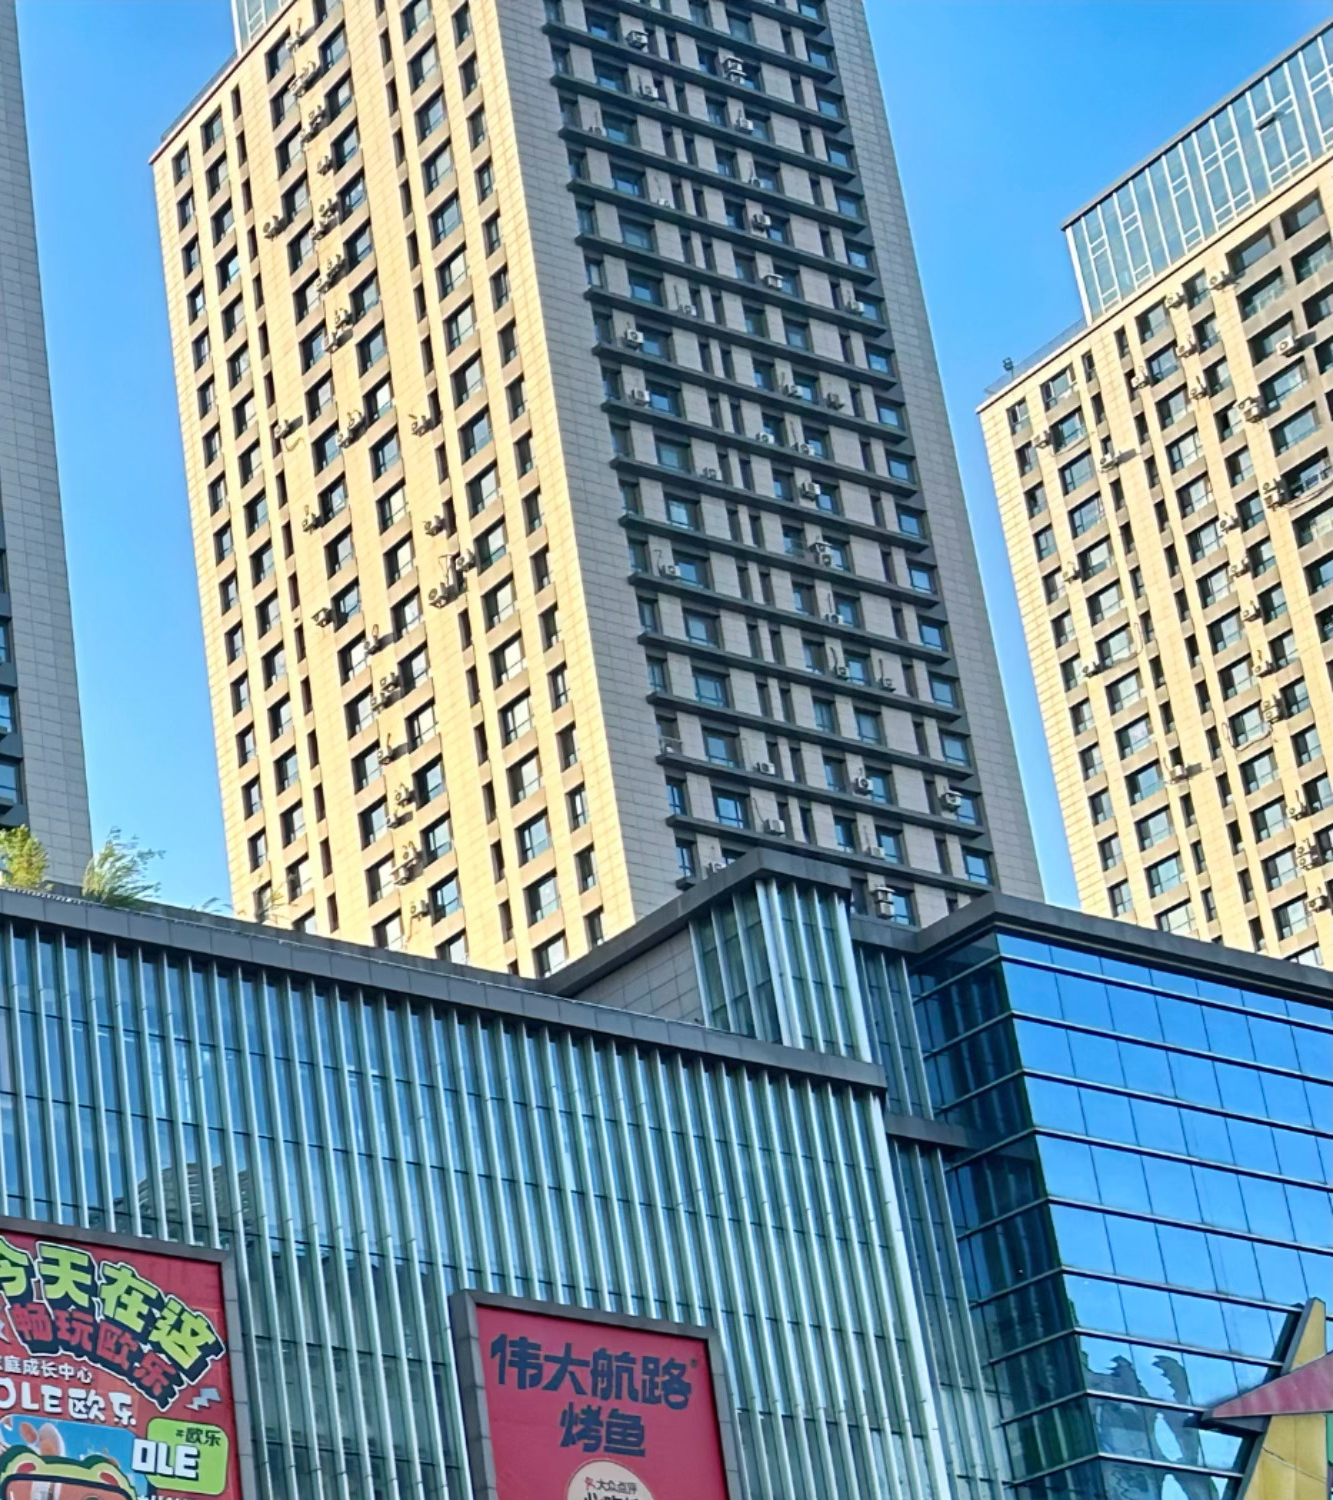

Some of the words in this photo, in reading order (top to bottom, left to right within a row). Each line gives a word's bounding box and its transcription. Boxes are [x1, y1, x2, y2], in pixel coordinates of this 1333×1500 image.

[9, 1302, 177, 1398] 畅玩欧乐
[490, 1333, 693, 1411] 伟大航路
[131, 1438, 200, 1481] OLE
[559, 1402, 647, 1458] 烤鱼
